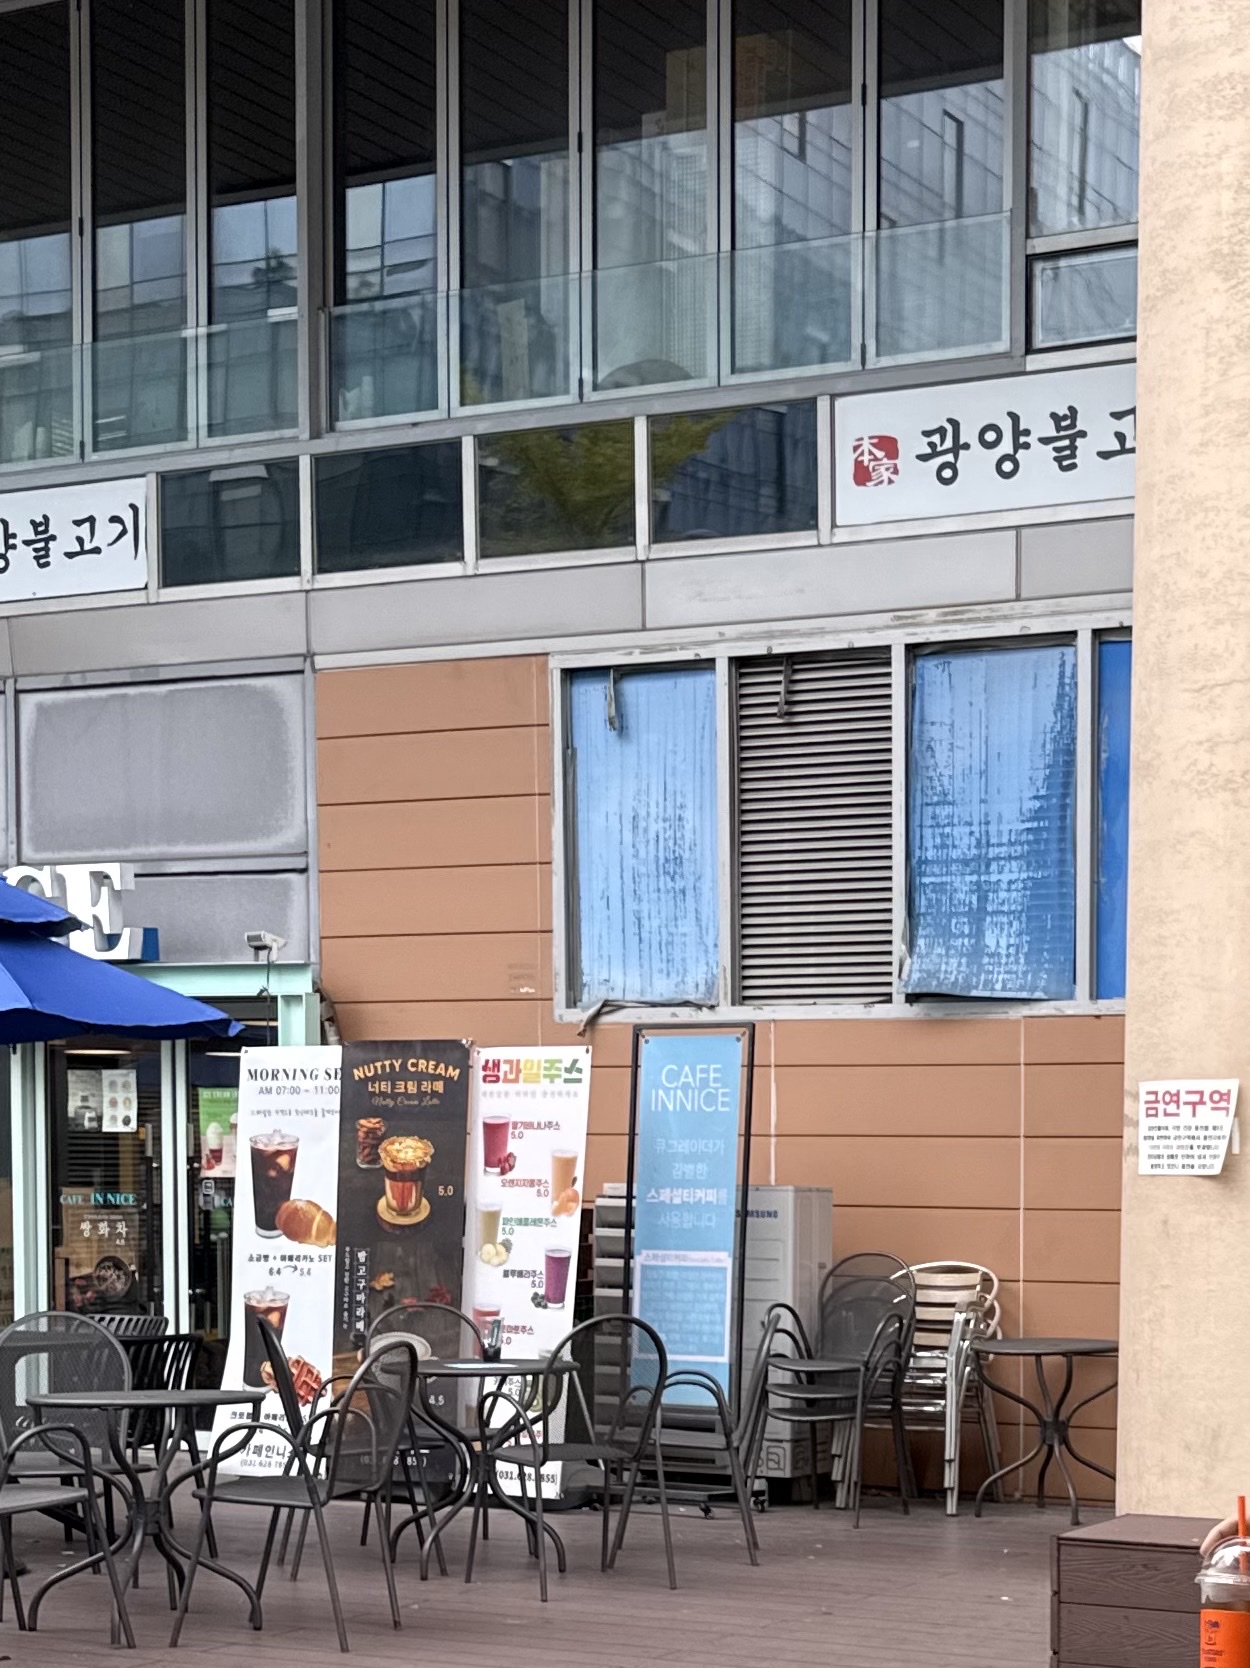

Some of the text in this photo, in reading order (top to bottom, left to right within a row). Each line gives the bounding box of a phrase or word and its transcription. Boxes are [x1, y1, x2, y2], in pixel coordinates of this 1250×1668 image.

[247, 1068, 319, 1081] MORNING
[352, 1059, 460, 1081] NUTTY CREAM
[482, 1059, 583, 1084] 생과일주스
[661, 1064, 722, 1088] CAFE
[259, 1086, 273, 1095] AM
[368, 1080, 444, 1094] 너티 크림 라떼
[651, 1089, 730, 1112] INNICE
[1144, 1089, 1231, 1118] 금연구역
[655, 1139, 725, 1155] 큐그레이더가
[438, 1185, 454, 1196] 5.0
[736, 1209, 778, 1219] SMSUNG
[318, 1254, 332, 1262] SET
[531, 1280, 544, 1288] 5.0
[428, 1395, 445, 1406] 4.5
